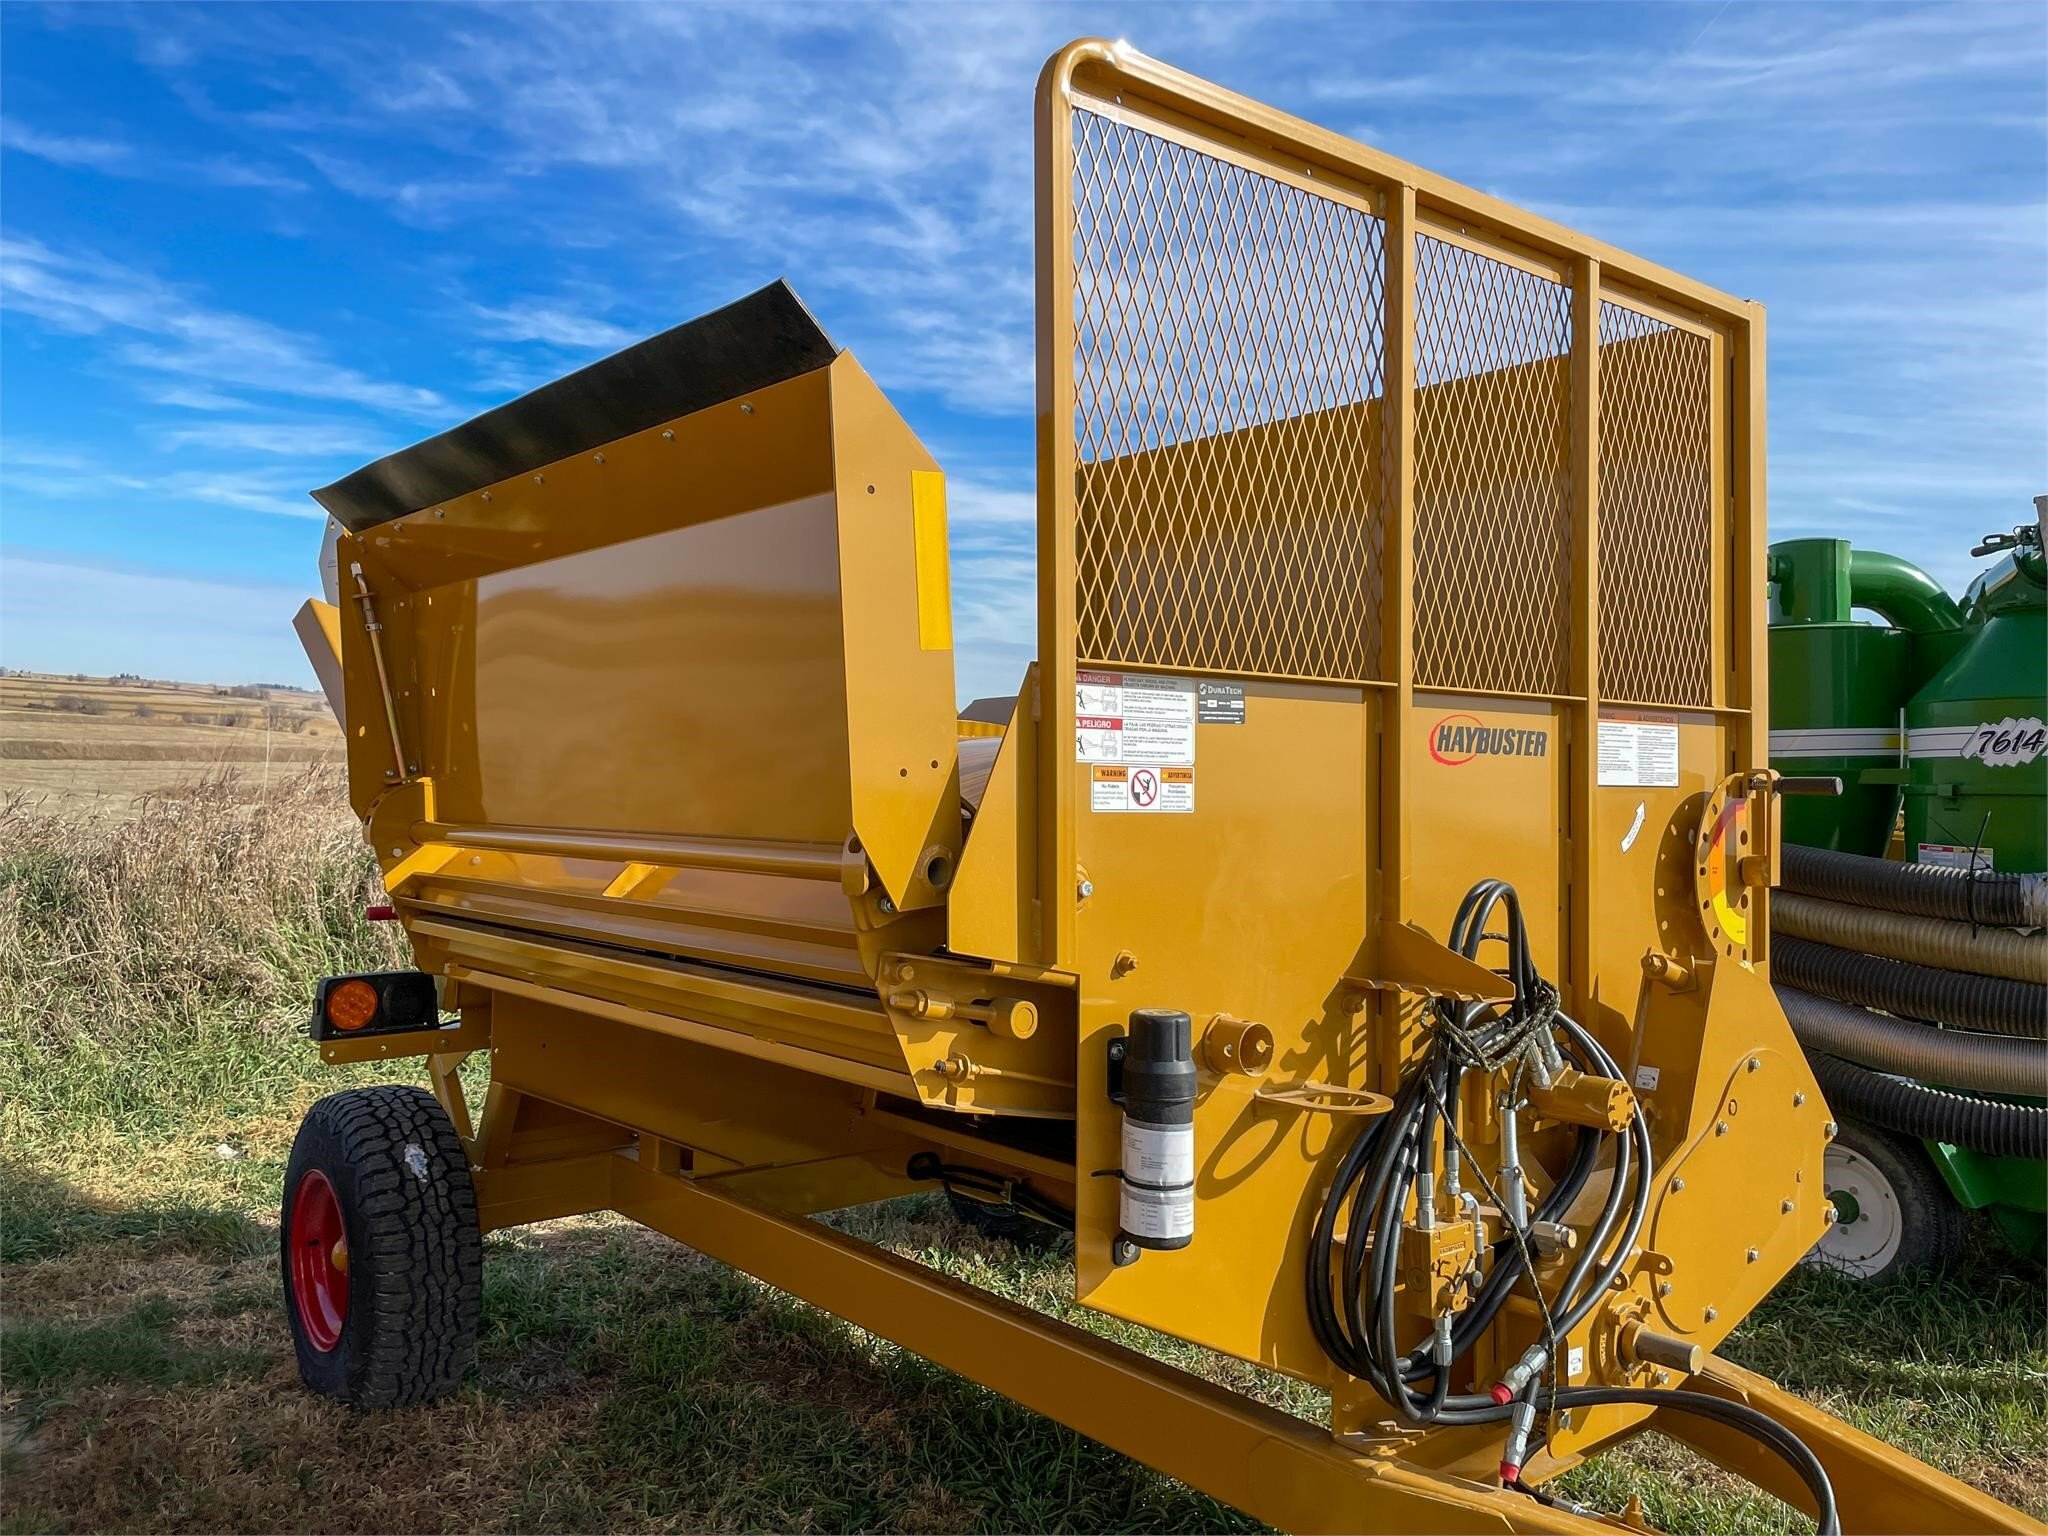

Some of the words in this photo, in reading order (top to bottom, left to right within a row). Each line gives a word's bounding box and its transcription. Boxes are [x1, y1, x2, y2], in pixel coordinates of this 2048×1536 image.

[1082, 674, 1111, 683] DANGER
[1082, 719, 1112, 728] PELIGRO
[1437, 725, 1548, 757] HAYBUSTER
[1978, 729, 2045, 755] 7614
[1101, 769, 1127, 777] WARNING
